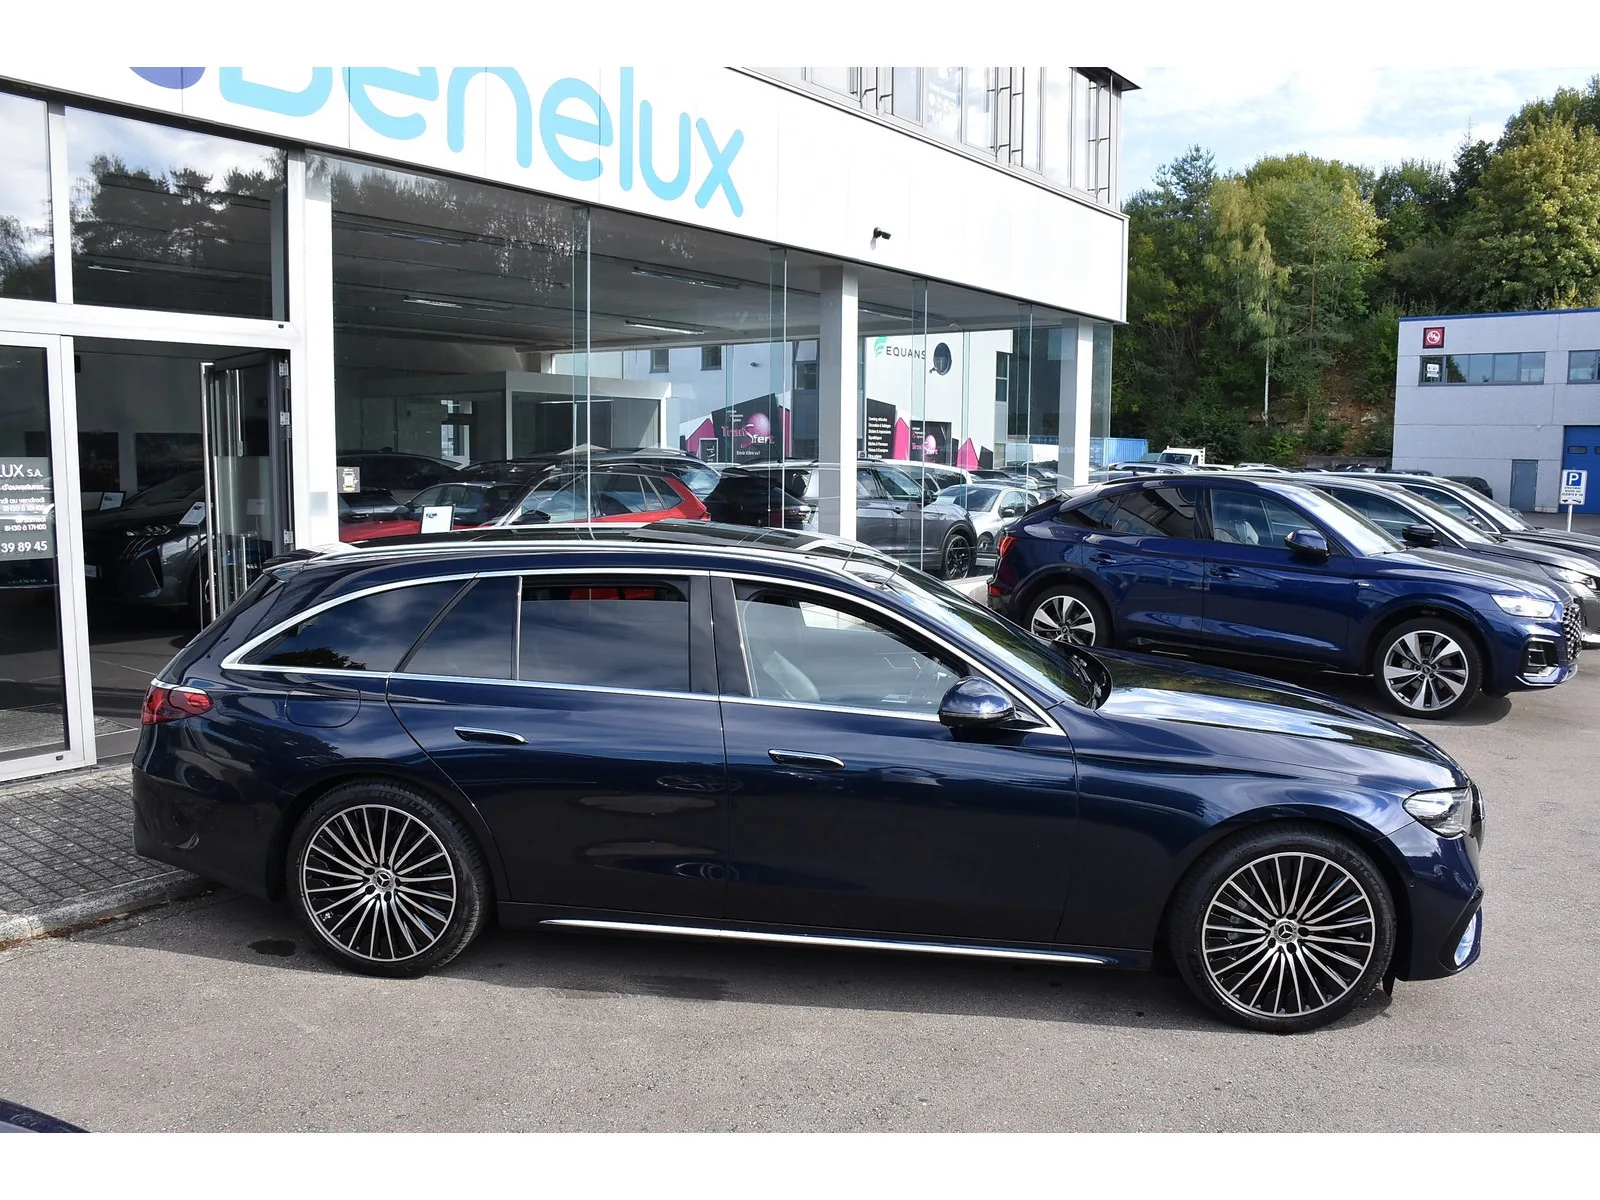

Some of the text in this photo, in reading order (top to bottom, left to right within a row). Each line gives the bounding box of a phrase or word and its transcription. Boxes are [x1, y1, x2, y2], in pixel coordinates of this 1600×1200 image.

[886, 346, 926, 360] EQUANS
[1568, 473, 1580, 486] P
[1, 540, 48, 553] 39 89 45
